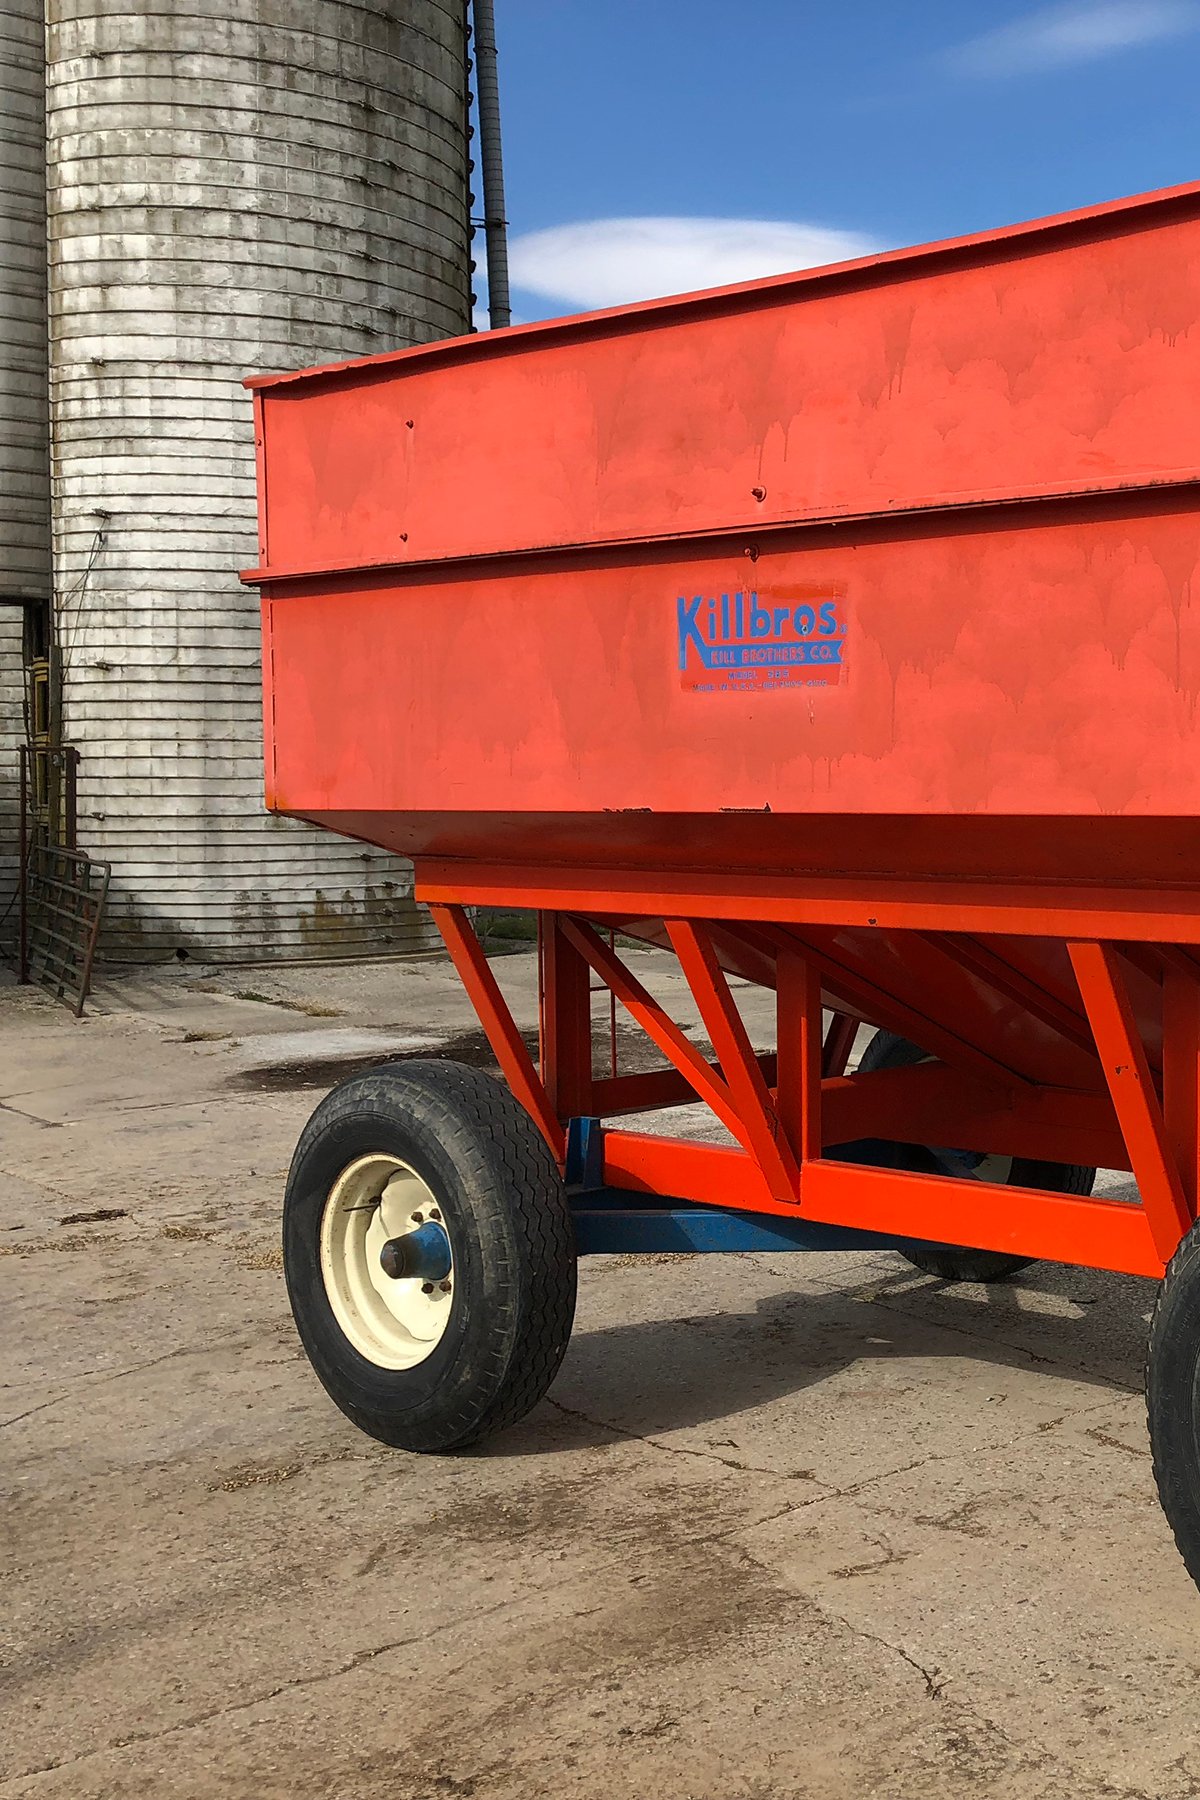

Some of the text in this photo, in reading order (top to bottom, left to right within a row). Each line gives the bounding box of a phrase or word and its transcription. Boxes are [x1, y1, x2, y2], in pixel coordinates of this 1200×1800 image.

[677, 591, 837, 670] Killbros
[711, 645, 834, 665] KILL BROTHERS CO.
